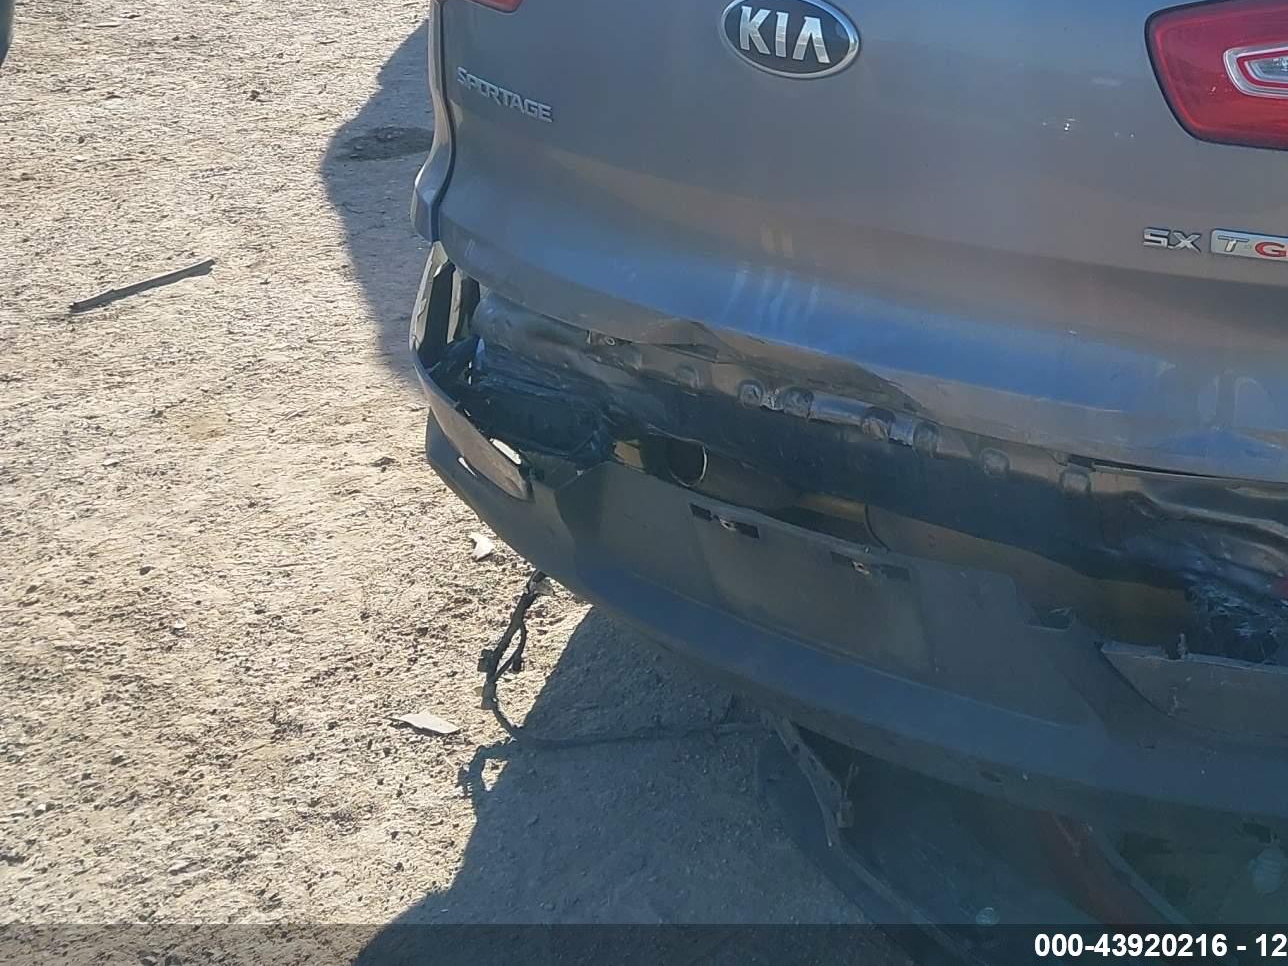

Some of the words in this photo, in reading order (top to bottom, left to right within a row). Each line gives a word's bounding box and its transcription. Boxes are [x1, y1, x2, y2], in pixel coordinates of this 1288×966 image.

[740, 5, 831, 64] KIA
[457, 66, 553, 123] SPORTAGE
[1143, 227, 1201, 252] SX
